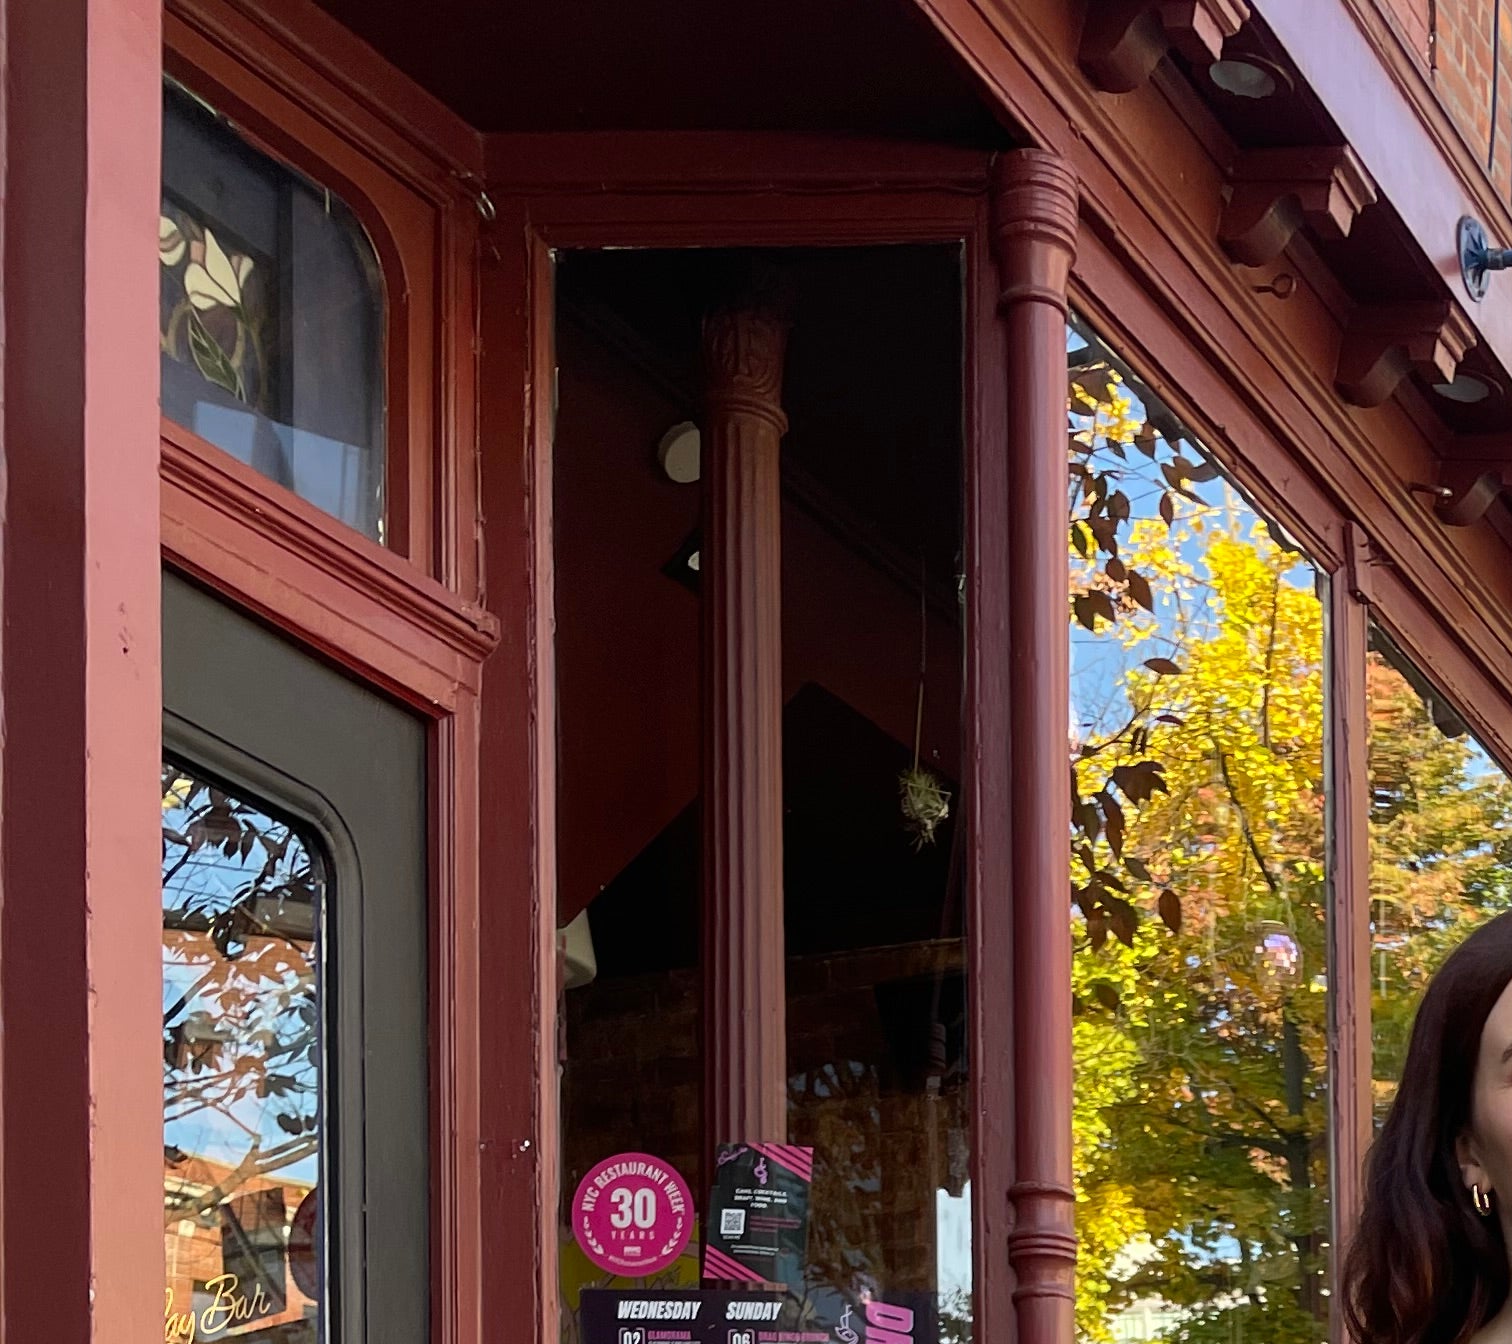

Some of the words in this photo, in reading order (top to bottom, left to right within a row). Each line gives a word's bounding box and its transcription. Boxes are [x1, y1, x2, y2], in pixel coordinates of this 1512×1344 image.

[581, 1186, 600, 1212] NYC
[594, 1161, 669, 1190] RESTAURANT
[664, 1180, 685, 1214] WEEK
[610, 1187, 656, 1229] 30
[611, 1230, 655, 1240] YEARS
[201, 1273, 271, 1334] Bar
[617, 1301, 701, 1320] WEDNESDAY
[725, 1301, 782, 1320] SUNDAY
